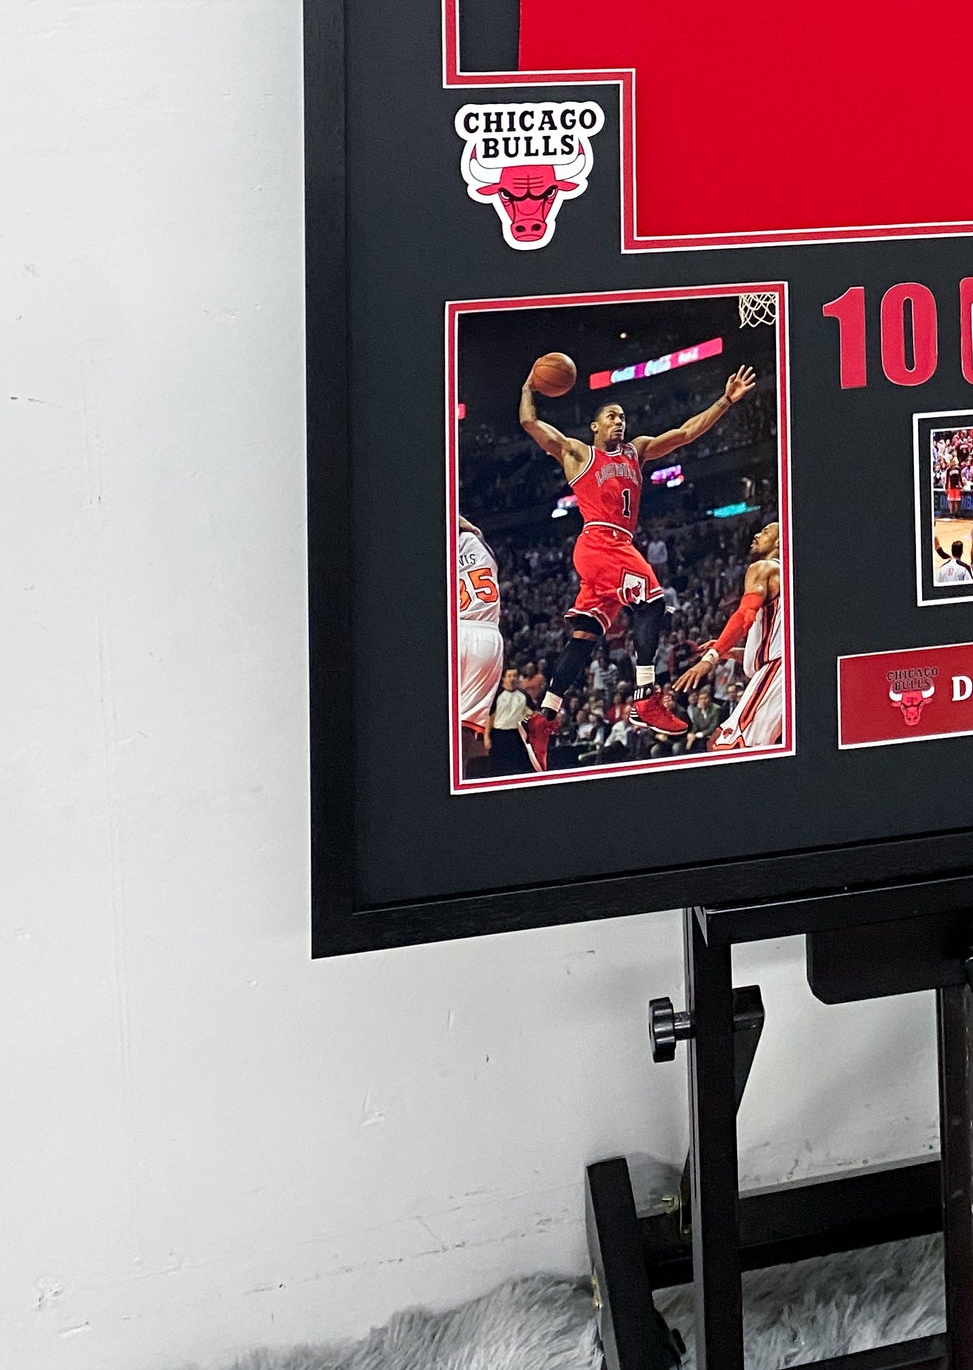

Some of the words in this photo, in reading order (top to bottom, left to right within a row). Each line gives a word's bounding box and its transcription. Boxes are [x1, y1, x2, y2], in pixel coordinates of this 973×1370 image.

[463, 109, 597, 134] CHICAGO
[482, 134, 574, 158] BULLS
[822, 282, 938, 389] 10
[622, 488, 631, 518] 1
[887, 667, 938, 681] CHICAGO
[895, 679, 931, 691] BULLS
